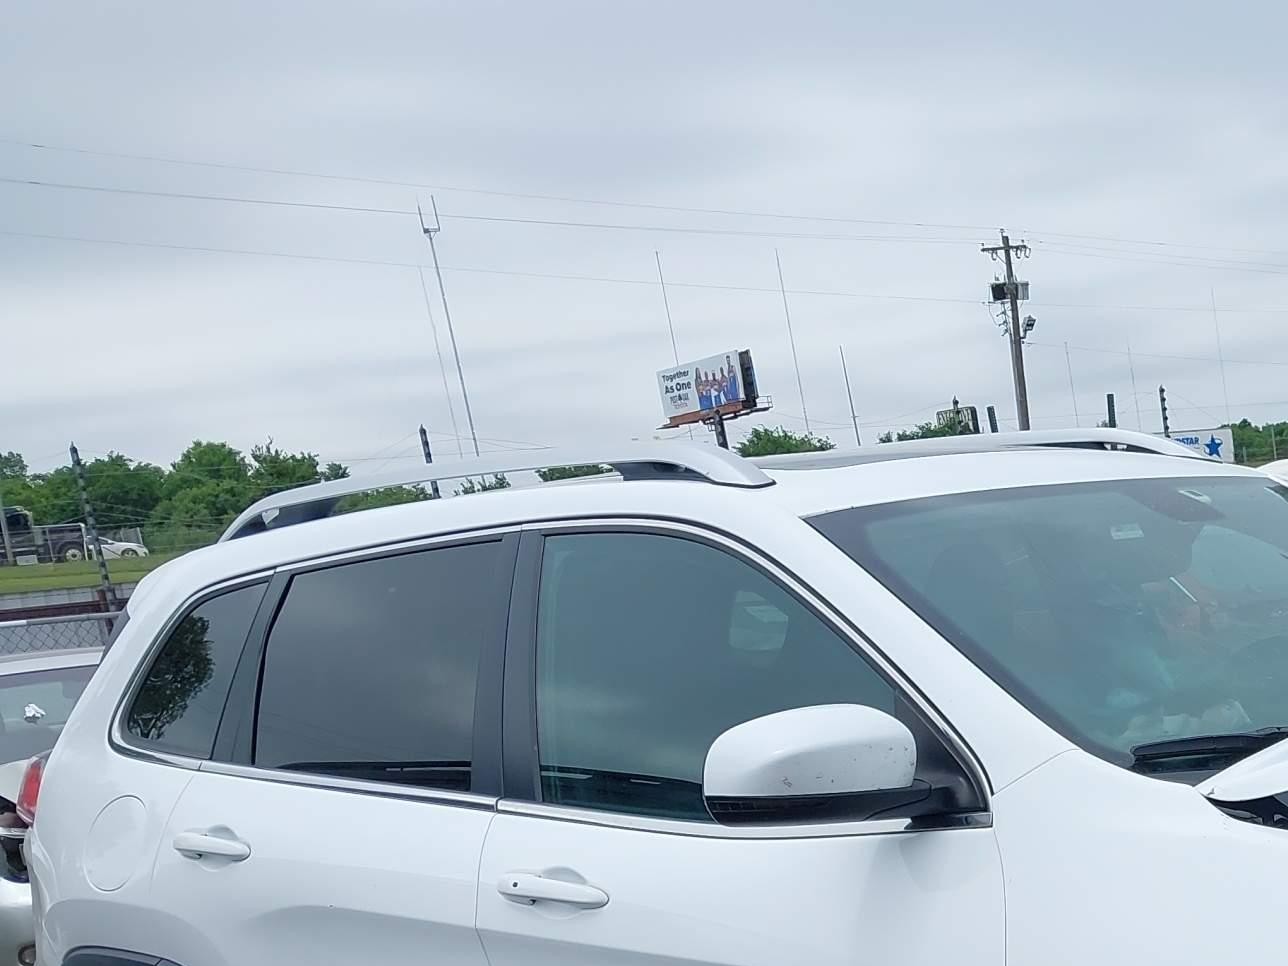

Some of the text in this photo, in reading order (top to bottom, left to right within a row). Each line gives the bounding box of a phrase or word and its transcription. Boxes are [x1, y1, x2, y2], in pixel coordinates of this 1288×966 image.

[662, 370, 689, 383] Together
[665, 381, 692, 395] As One
